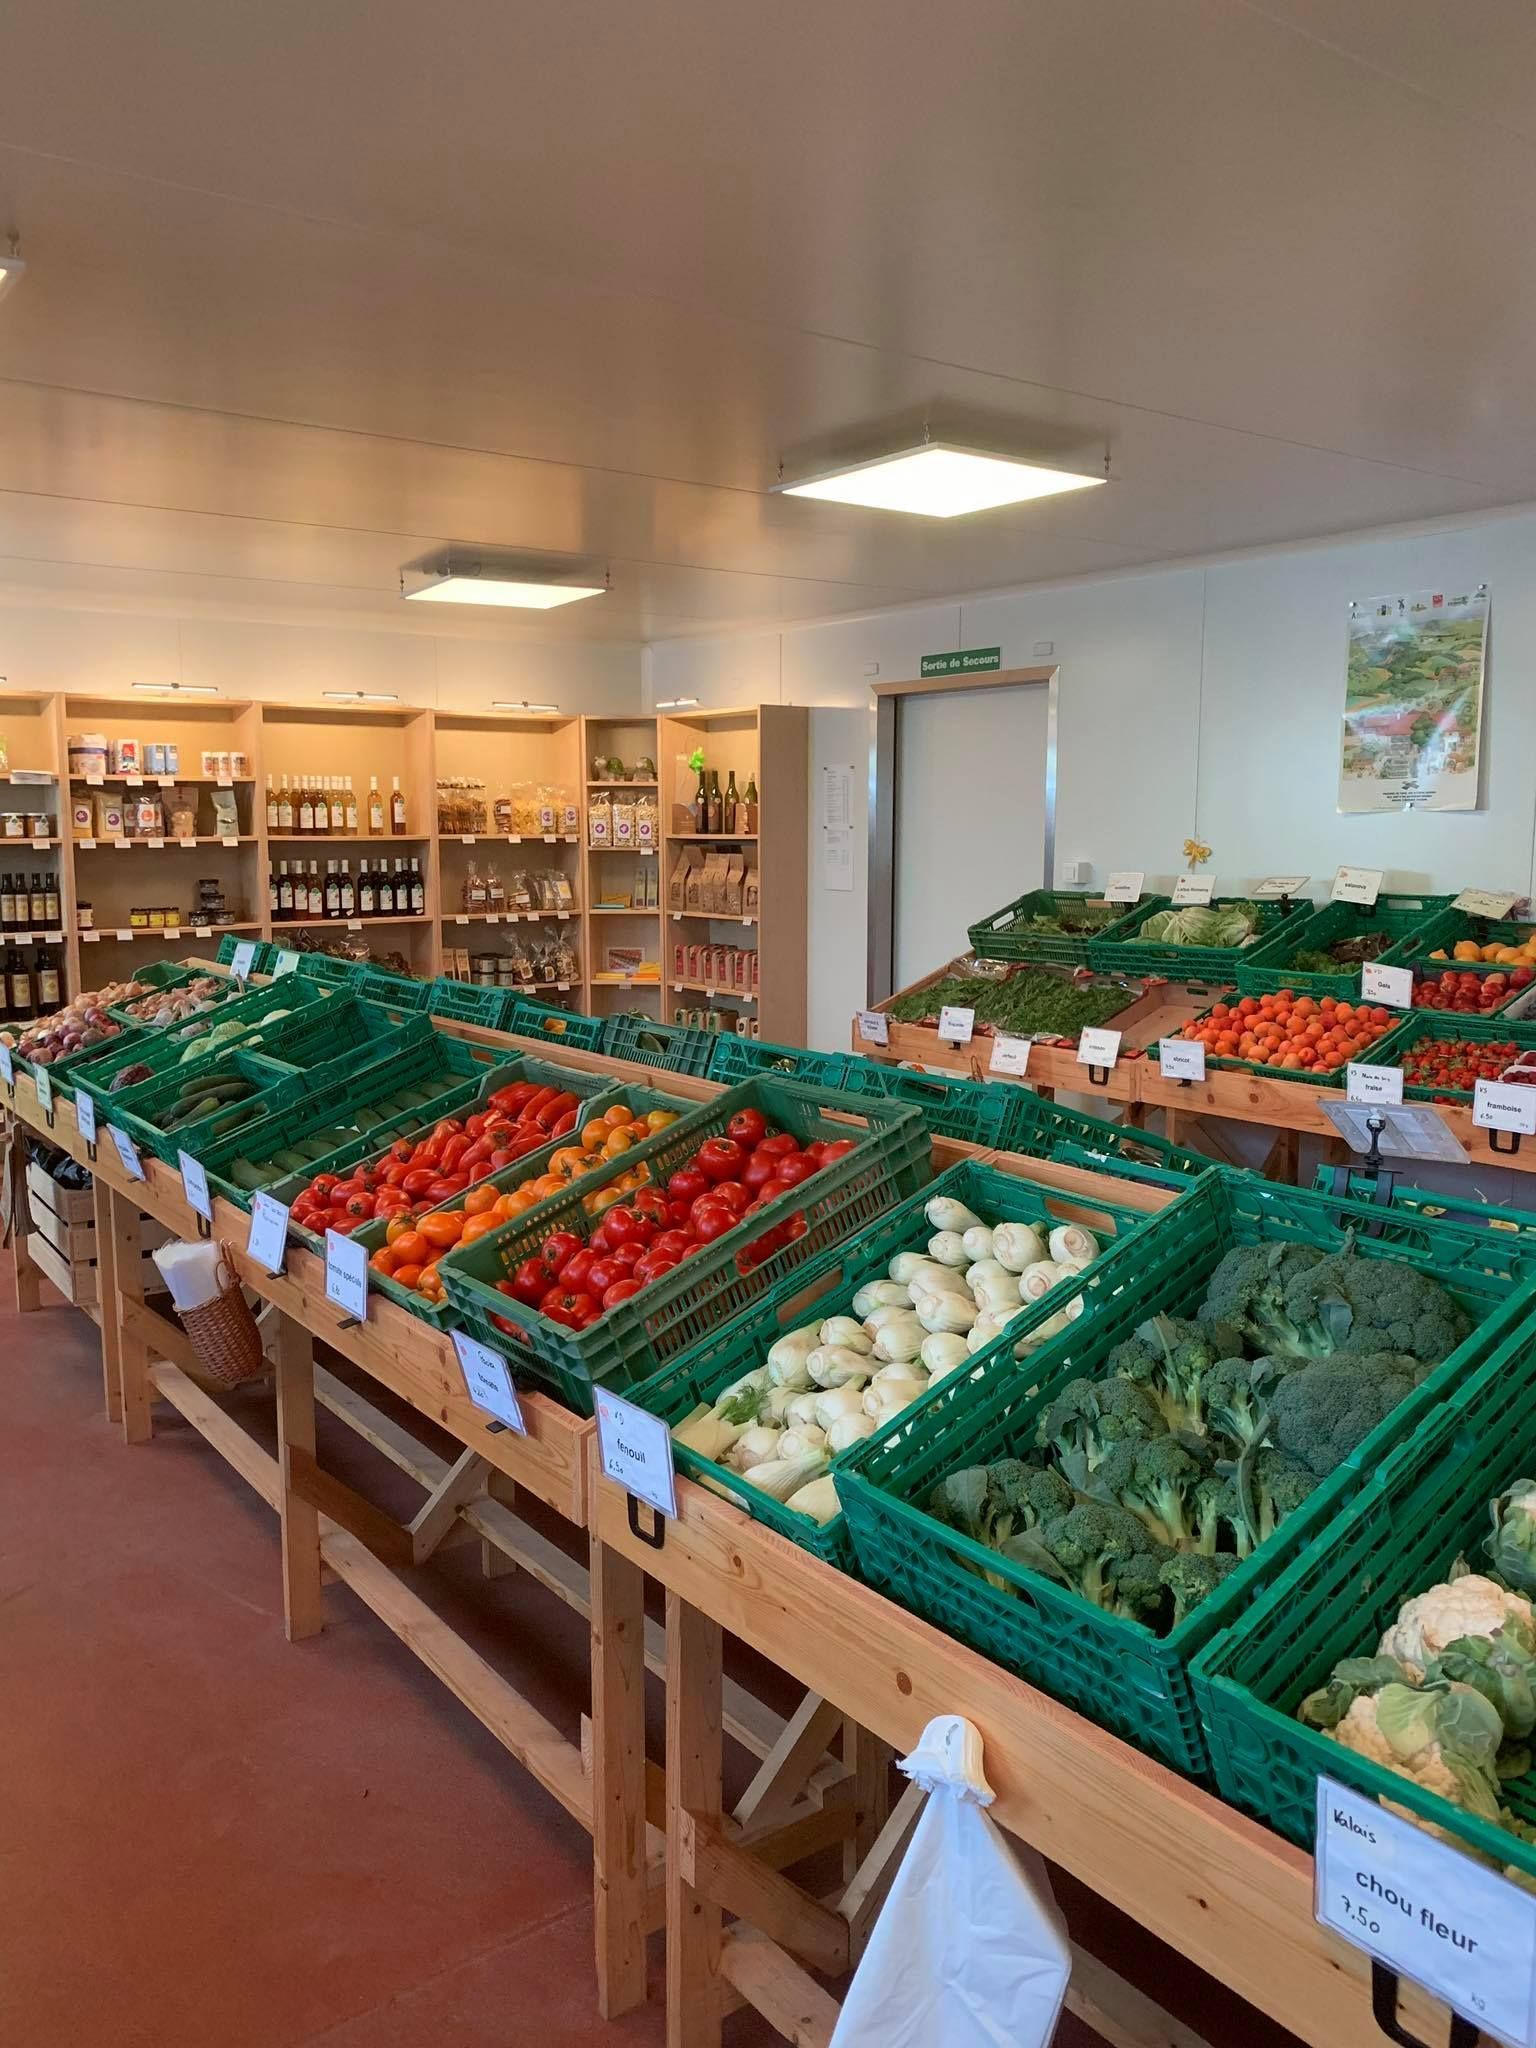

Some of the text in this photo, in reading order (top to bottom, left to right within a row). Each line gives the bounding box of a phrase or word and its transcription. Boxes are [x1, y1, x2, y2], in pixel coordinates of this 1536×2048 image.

[922, 655, 999, 671] Sortie de Secours
[1377, 981, 1391, 989] Gala
[1365, 1083, 1383, 1092] fraise
[1479, 1086, 1488, 1094] VS
[1487, 1101, 1522, 1114] framboise
[617, 1438, 646, 1464] fenouil
[609, 1458, 624, 1474] 6.50
[1333, 1808, 1377, 1844] Valais
[1341, 1894, 1380, 1934] 7.50
[1356, 1871, 1479, 1954] chou fleur
[1471, 1991, 1486, 2011] kg
